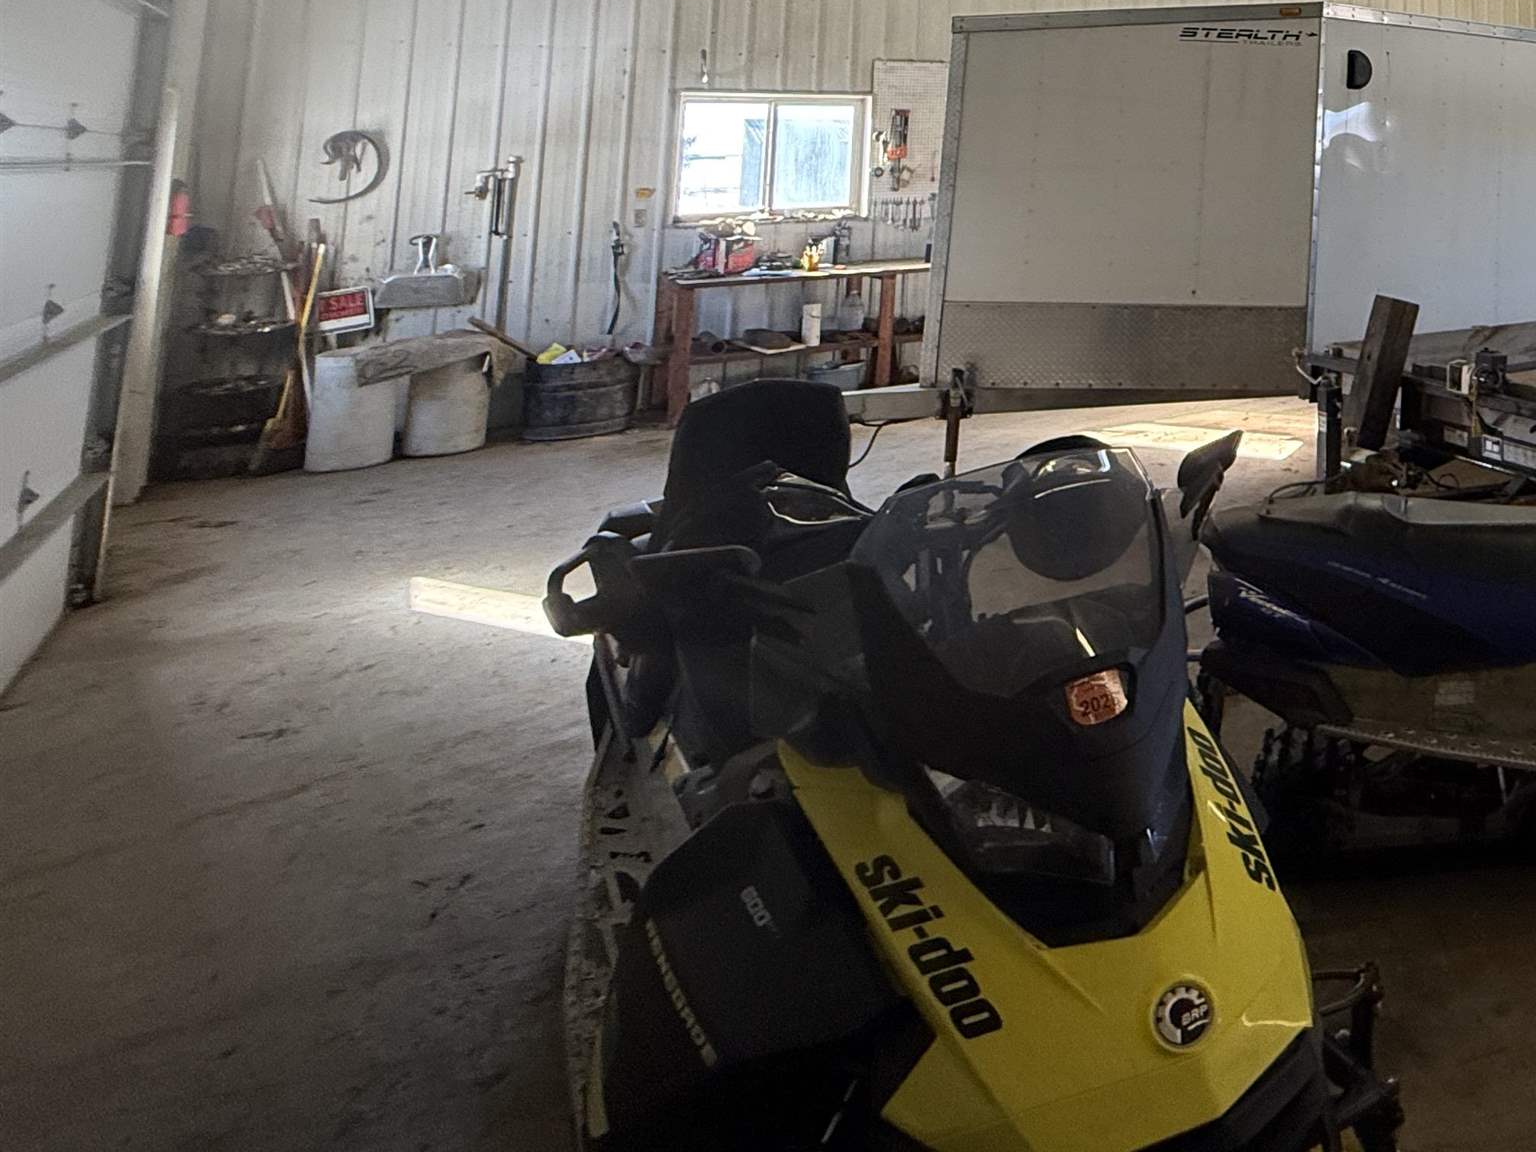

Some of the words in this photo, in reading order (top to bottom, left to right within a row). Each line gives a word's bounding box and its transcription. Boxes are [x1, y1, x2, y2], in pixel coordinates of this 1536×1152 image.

[1179, 27, 1303, 40] STEALTH
[329, 293, 364, 310] SALE
[1186, 726, 1277, 892] ski-doo
[855, 854, 1003, 1039] ski-doo
[1181, 1004, 1209, 1026] BRP
